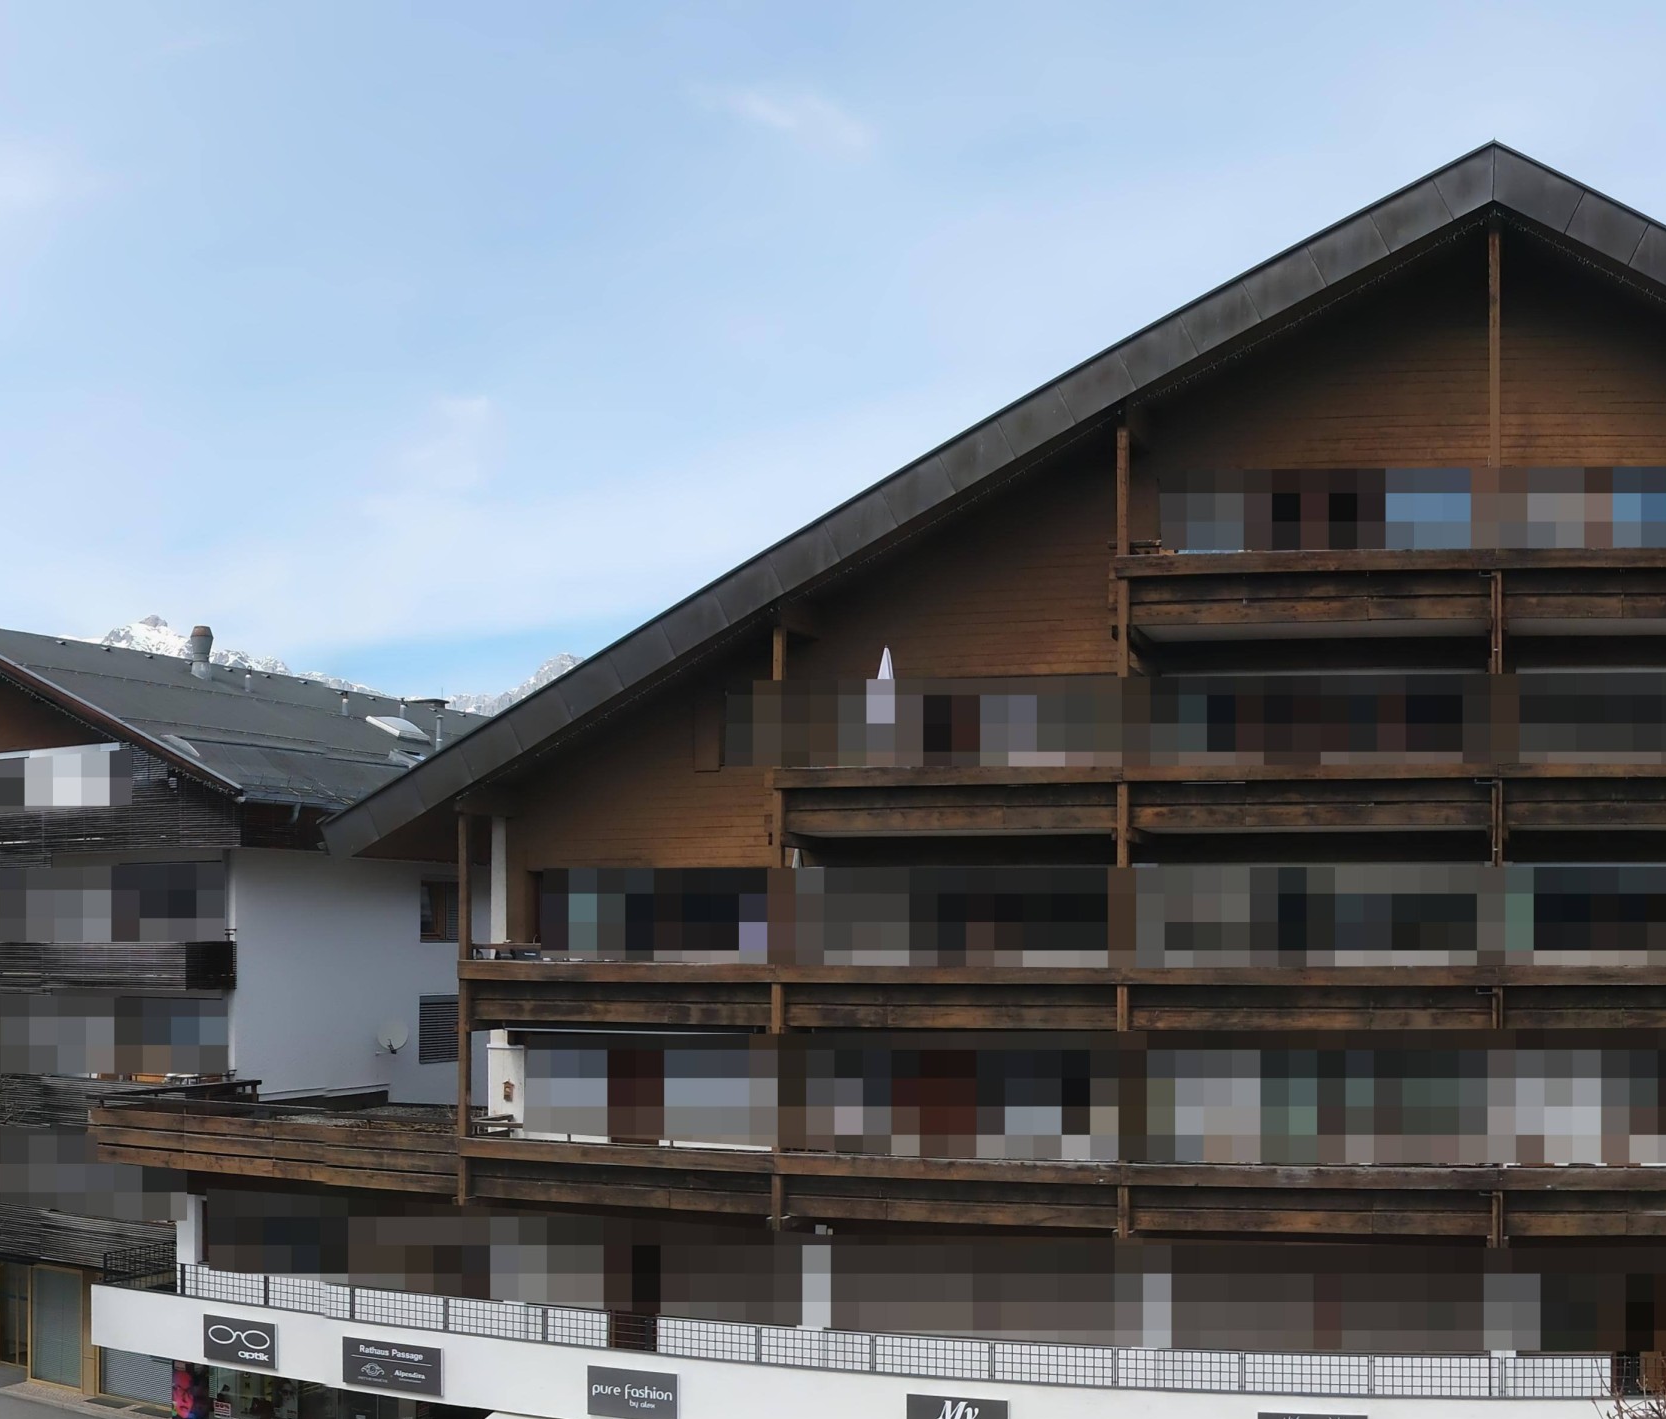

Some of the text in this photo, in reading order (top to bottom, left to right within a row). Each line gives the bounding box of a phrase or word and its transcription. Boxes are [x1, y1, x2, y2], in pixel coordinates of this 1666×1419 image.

[238, 1350, 269, 1362] optik
[359, 1344, 423, 1361] Rathaus Passage
[592, 1383, 673, 1401] pure fashion
